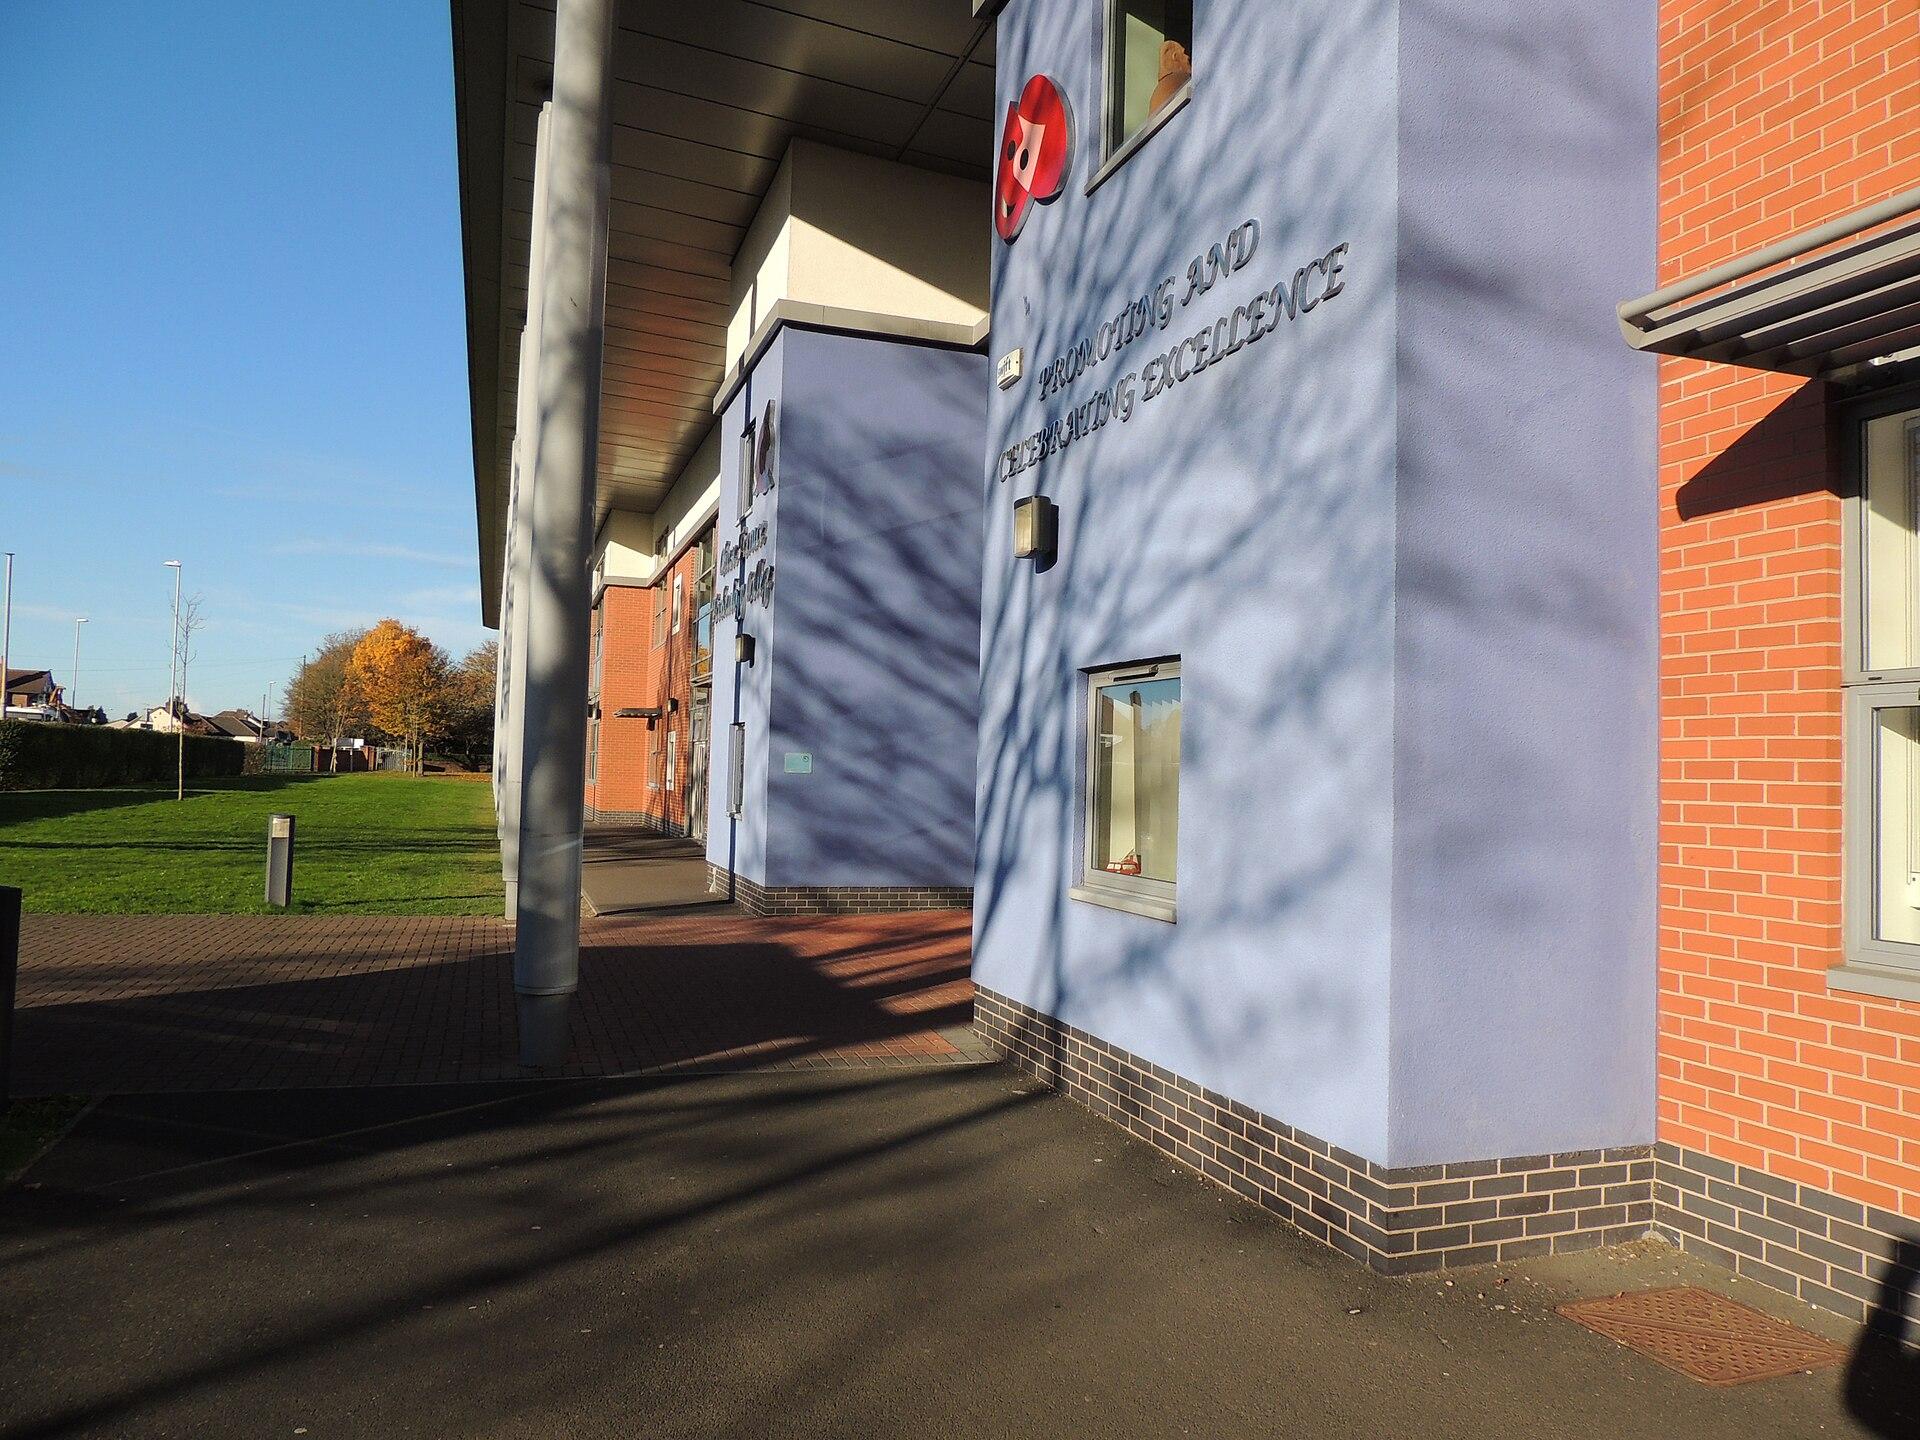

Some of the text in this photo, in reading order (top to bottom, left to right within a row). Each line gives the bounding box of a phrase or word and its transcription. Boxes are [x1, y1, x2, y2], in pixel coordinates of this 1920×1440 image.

[999, 241, 1350, 483] CELEBRATING EXCELLENCE
[1038, 218, 1261, 401] PROMOTING AND
